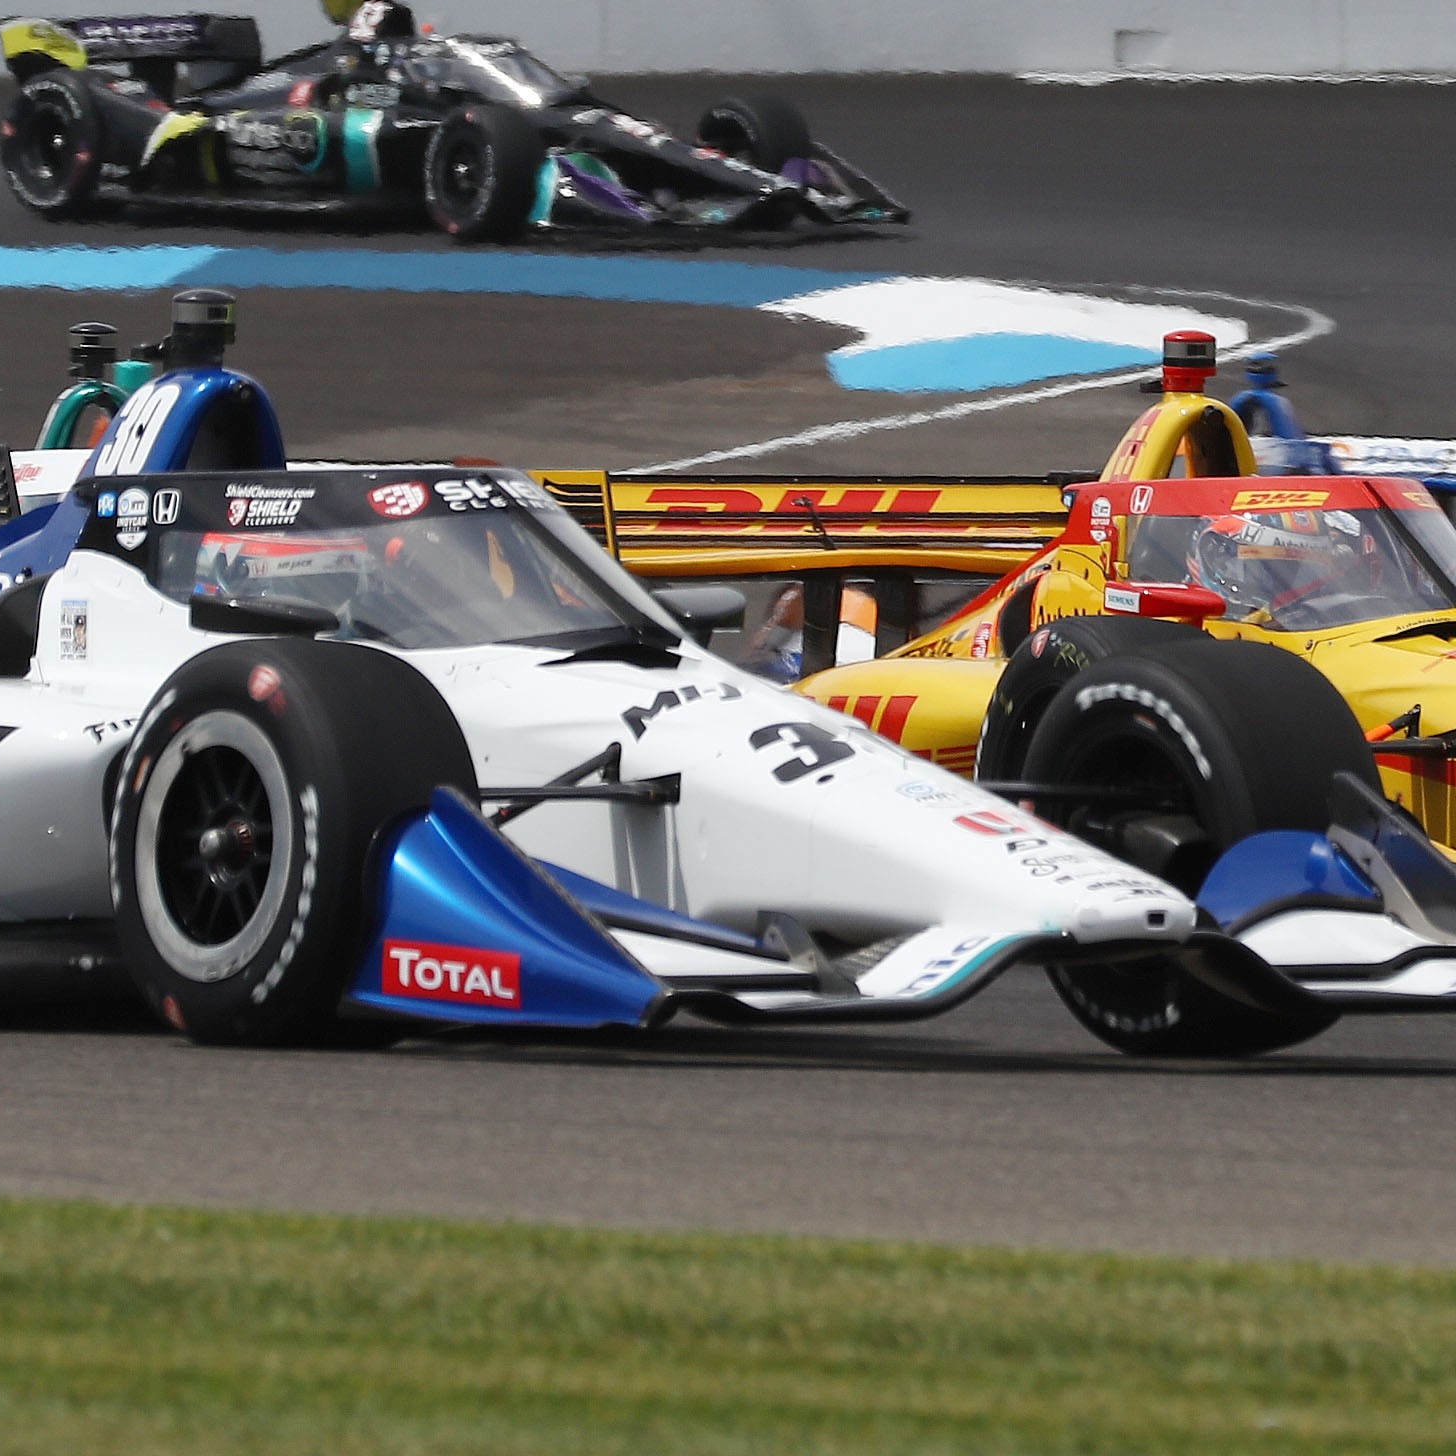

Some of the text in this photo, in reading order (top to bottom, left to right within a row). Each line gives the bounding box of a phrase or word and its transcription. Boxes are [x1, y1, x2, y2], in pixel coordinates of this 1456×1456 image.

[1246, 493, 1312, 505] DHL
[248, 500, 301, 518] SHIELD
[644, 488, 970, 532] DHL
[245, 517, 296, 526] CLEANSERS
[389, 947, 516, 1000] TOTAL
